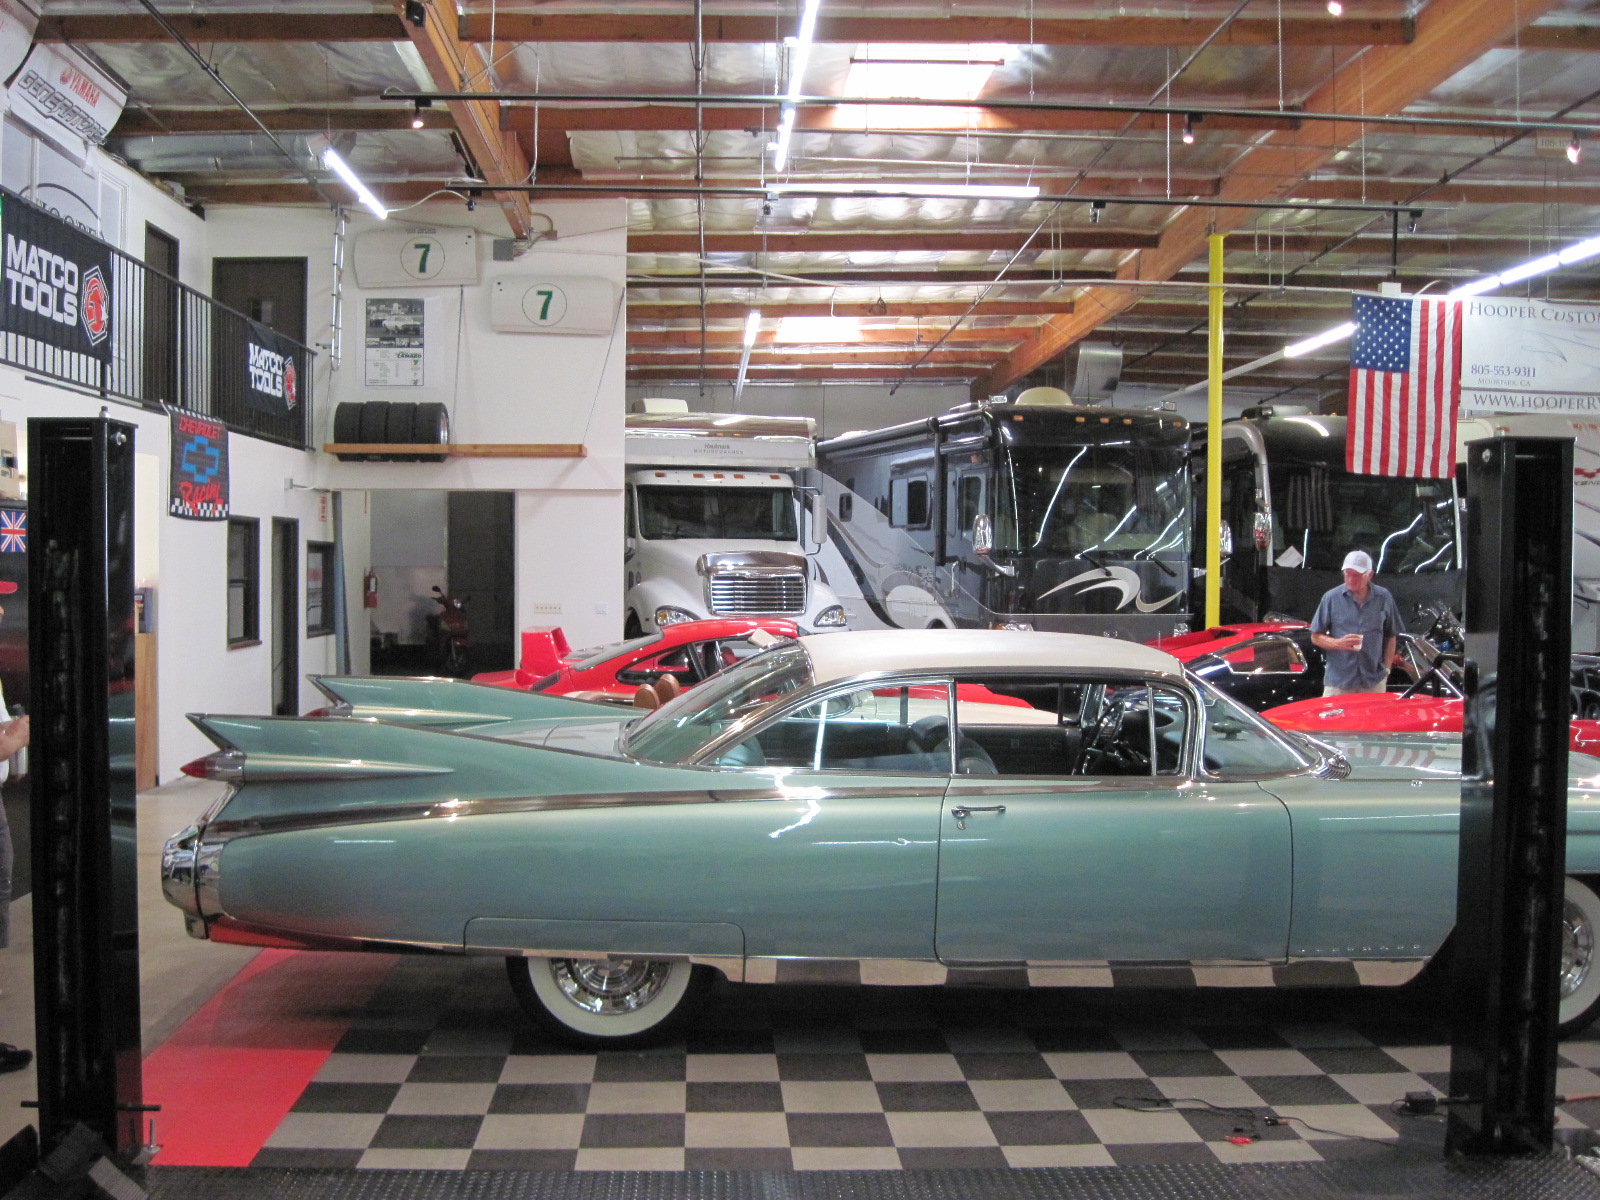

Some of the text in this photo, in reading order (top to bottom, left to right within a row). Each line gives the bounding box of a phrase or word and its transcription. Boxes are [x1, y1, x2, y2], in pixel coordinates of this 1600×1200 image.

[69, 71, 101, 108] YAMAHA
[7, 233, 79, 294] MATCO
[414, 243, 431, 273] 7
[6, 268, 78, 327] TOOLS
[536, 290, 553, 320] 7
[1469, 301, 1537, 319] HOOPER
[248, 342, 284, 376] MATCO
[1471, 363, 1536, 378] 805-553-9311
[248, 365, 283, 398] TOOLS
[179, 416, 223, 440] CHEVROLET
